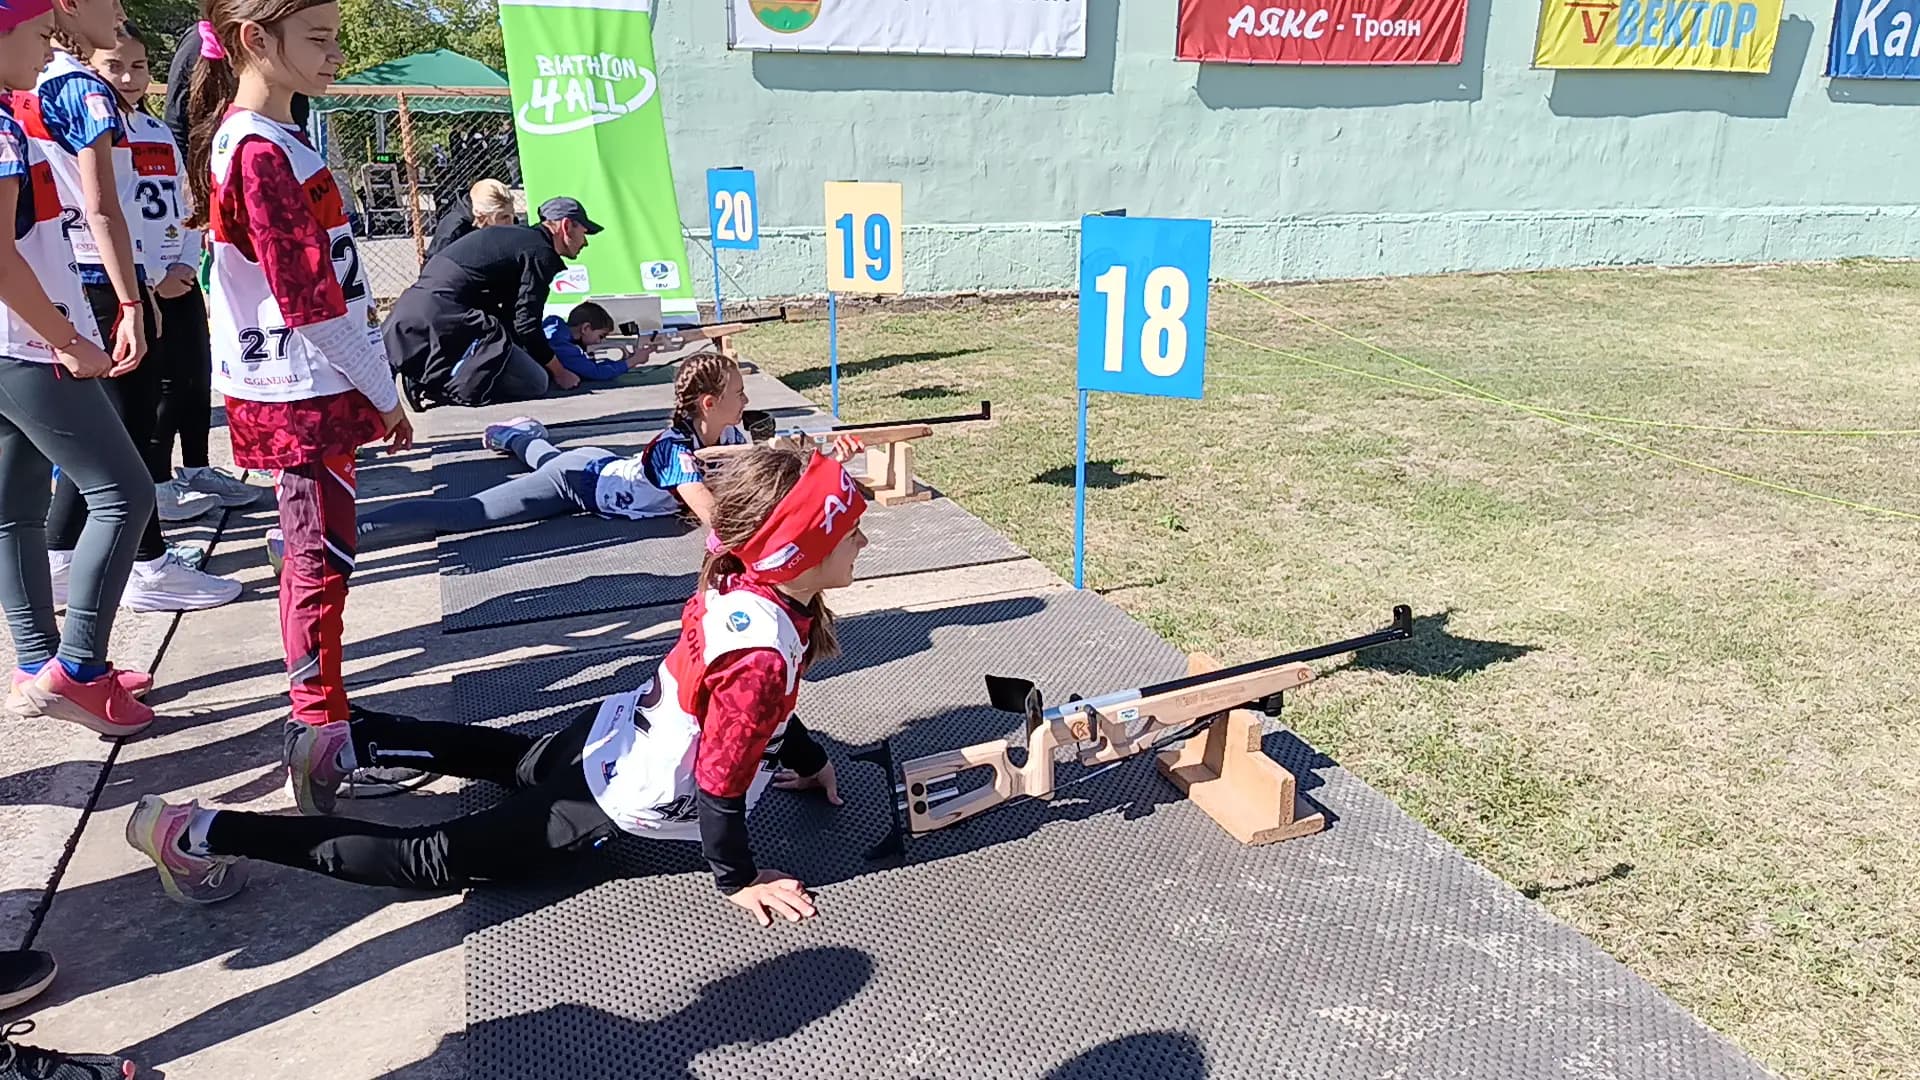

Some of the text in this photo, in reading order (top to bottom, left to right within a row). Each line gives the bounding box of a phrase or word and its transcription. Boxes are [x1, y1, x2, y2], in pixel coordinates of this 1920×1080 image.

[1228, 5, 1328, 39] АЯКС
[1352, 13, 1421, 42] Троян
[1615, 0, 1757, 48] ВЕКТОР
[1846, 0, 1920, 57] Ка
[535, 52, 637, 81] BIATHLON
[135, 180, 180, 220] 37
[715, 190, 753, 241] 20
[836, 213, 891, 281] 19
[239, 326, 294, 363] 27
[1095, 265, 1190, 377] 18
